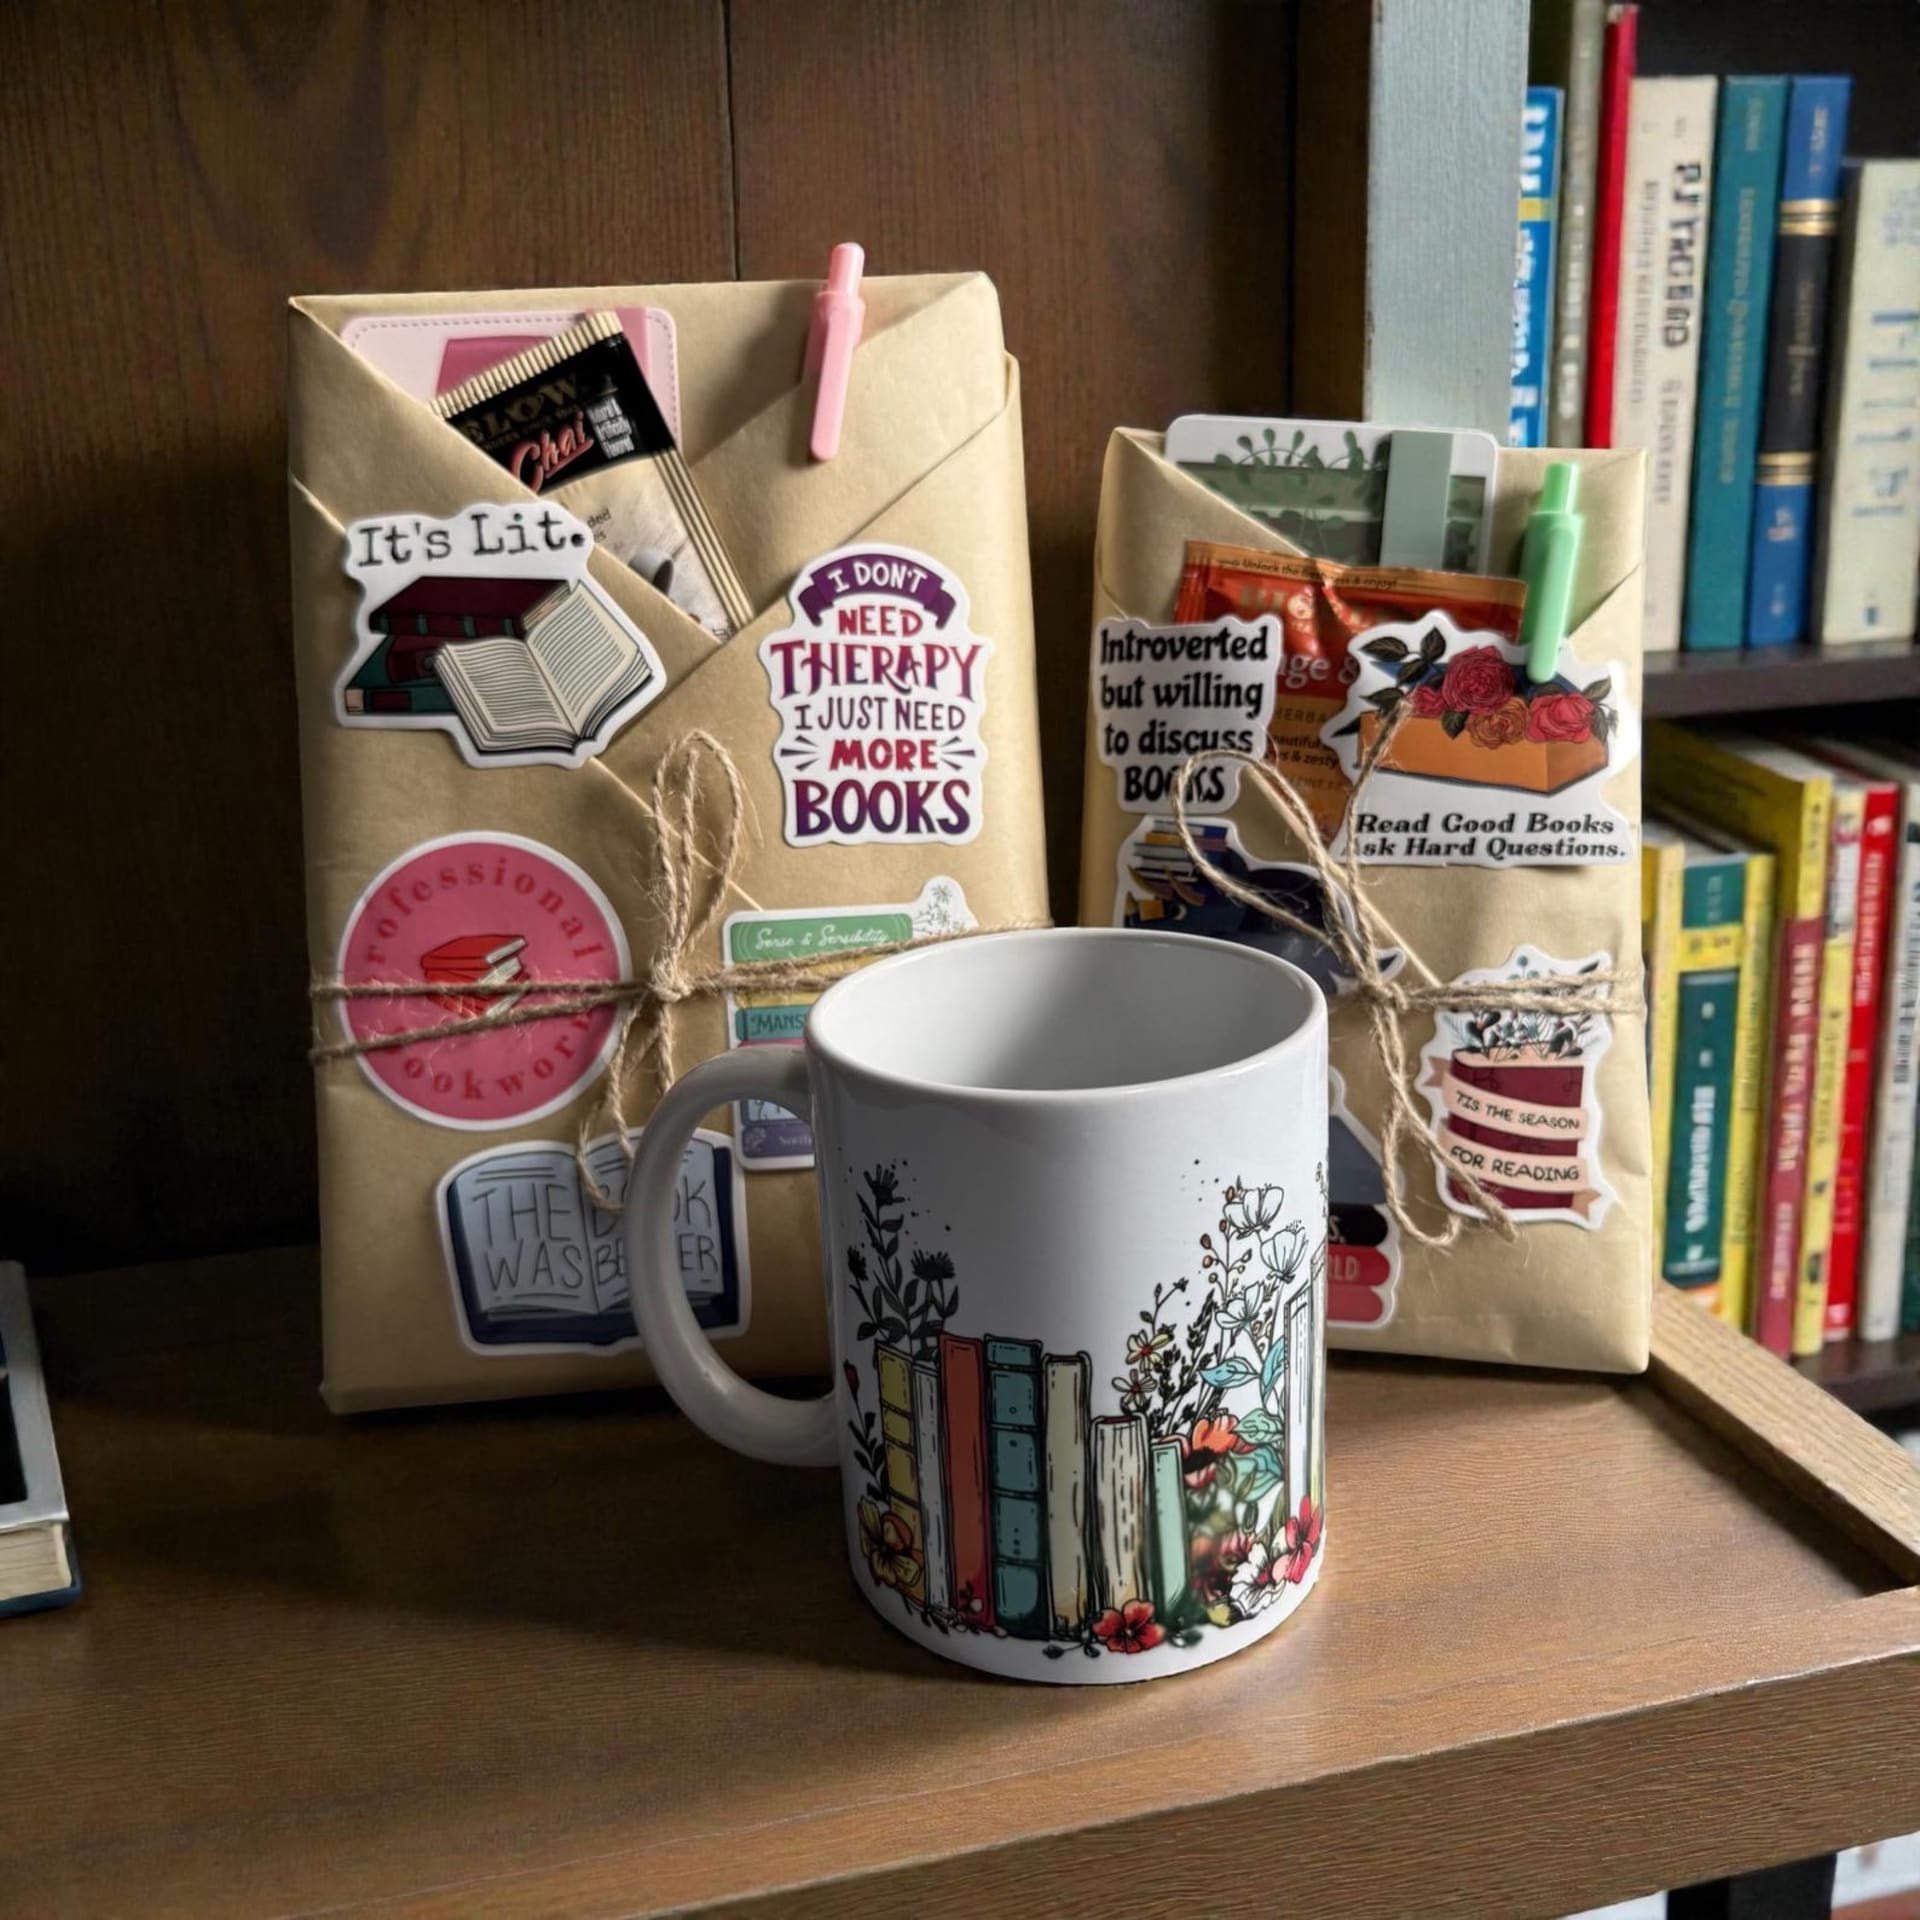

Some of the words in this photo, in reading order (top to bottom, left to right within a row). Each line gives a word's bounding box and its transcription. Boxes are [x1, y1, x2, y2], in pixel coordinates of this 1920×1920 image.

[510, 409, 594, 495] Chai
[357, 521, 452, 567] It's
[471, 510, 585, 556] Lit.
[828, 568, 850, 593] I
[855, 561, 928, 593] DON'T
[838, 605, 923, 637] NEED
[1101, 625, 1268, 664] Introverted
[770, 639, 984, 702] THERAPY
[794, 704, 812, 730] I
[818, 695, 888, 731] JUST
[895, 700, 966, 731] NEED
[1101, 675, 1145, 709] but
[1153, 672, 1263, 719] willing
[829, 738, 938, 771] MORE
[1105, 723, 1130, 755] to
[1138, 718, 1253, 755] discuss
[792, 778, 971, 837] BOOKS
[1355, 811, 1430, 834] Read
[1441, 811, 1517, 834] Good
[1526, 811, 1614, 834] Books
[1404, 837, 1476, 857] Hard
[1485, 837, 1626, 861] Questions.
[366, 857, 603, 966] rofessional
[756, 927, 795, 950] Sense
[801, 932, 813, 946] &
[756, 1014, 804, 1034] MANS
[384, 1010, 592, 1100] ookwor
[1486, 1103, 1512, 1122] THE
[1518, 1112, 1580, 1129] SEASON
[1451, 1145, 1485, 1170] FOR
[1492, 1159, 1579, 1182] READING
[472, 1183, 572, 1247] THE
[592, 1175, 712, 1238] BK
[484, 1239, 583, 1291] WAS
[596, 1233, 718, 1285] BEER
